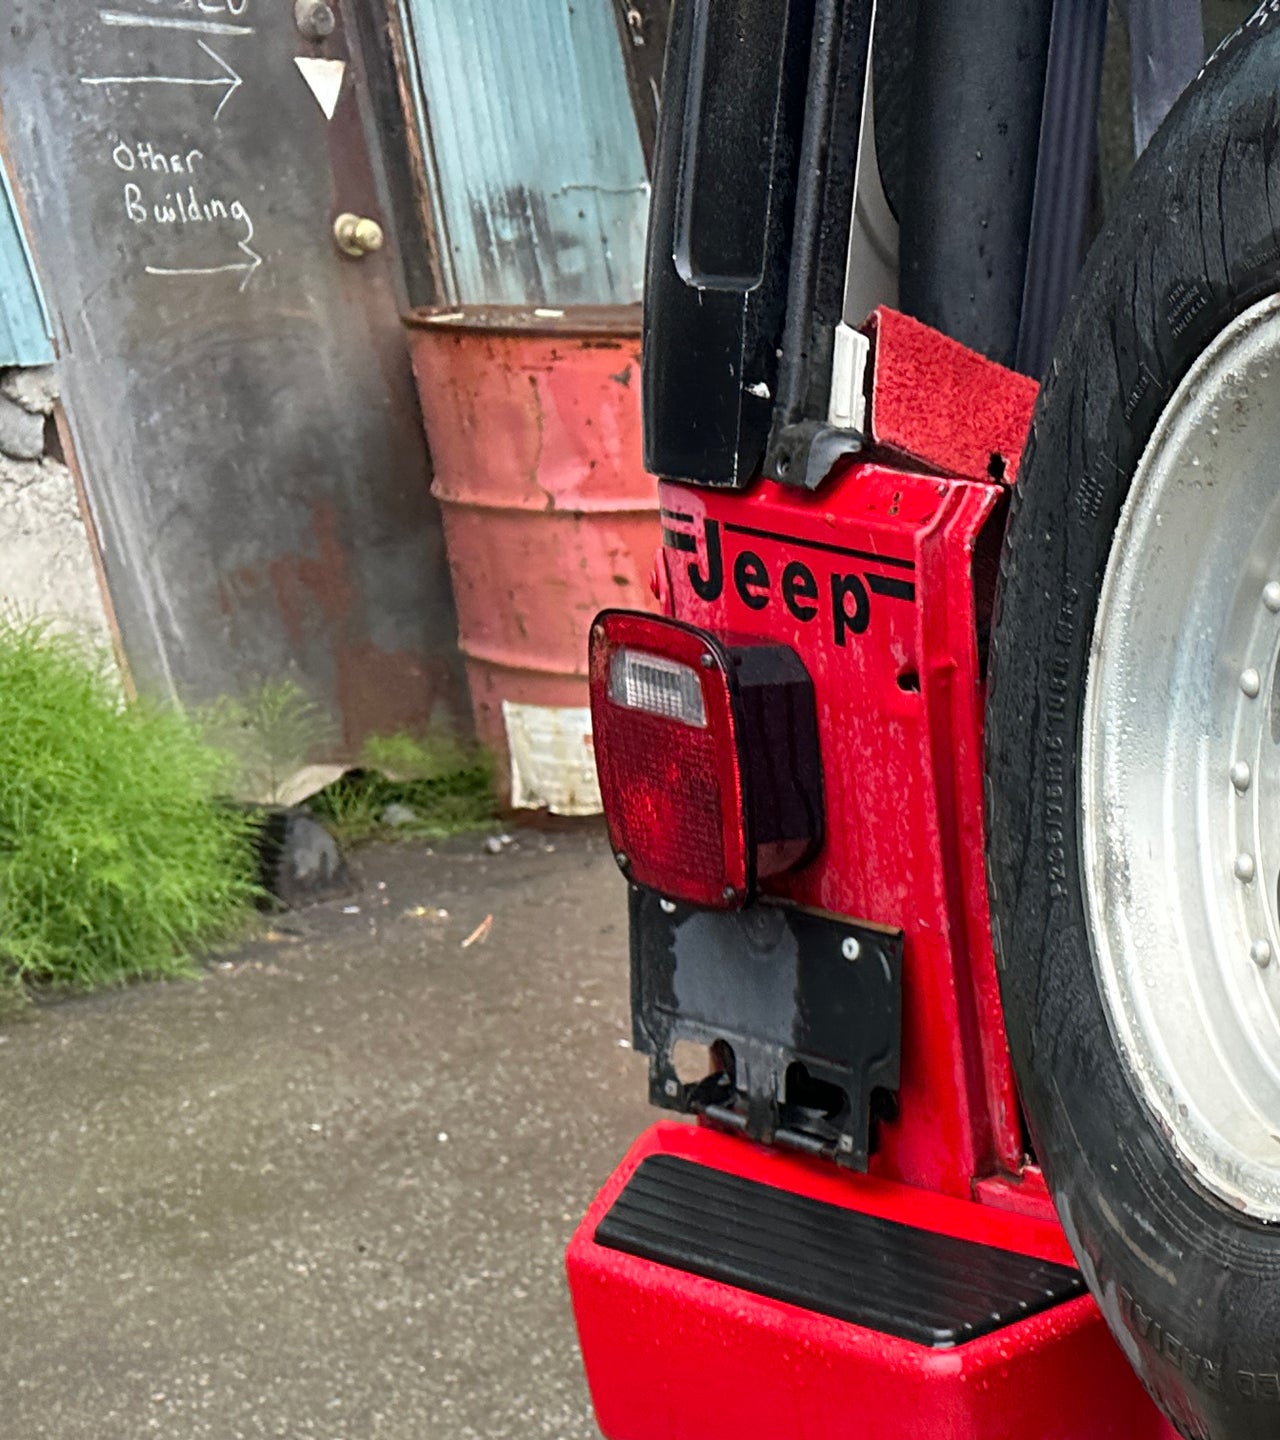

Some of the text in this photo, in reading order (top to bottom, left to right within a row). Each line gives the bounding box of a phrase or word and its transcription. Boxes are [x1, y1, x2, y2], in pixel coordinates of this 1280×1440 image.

[113, 140, 203, 174] Other
[125, 182, 254, 243] Building
[687, 518, 871, 648] Jeep
